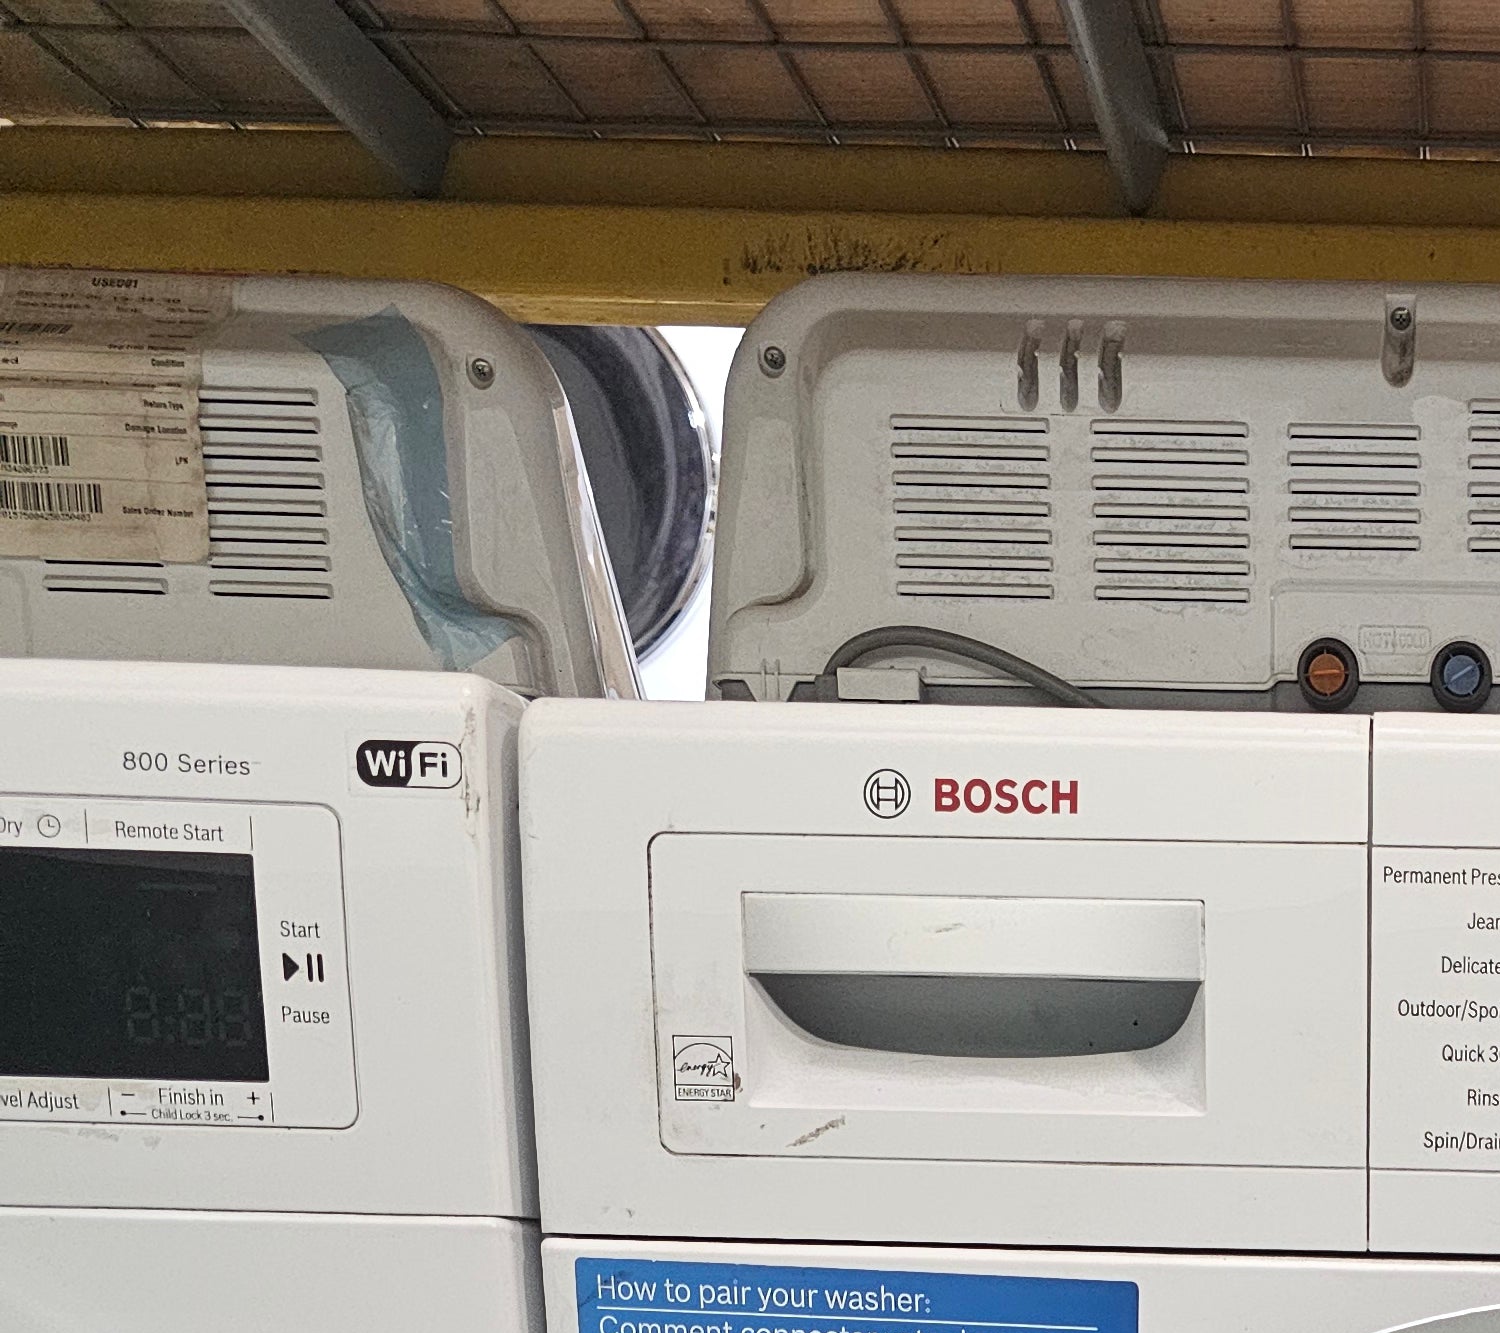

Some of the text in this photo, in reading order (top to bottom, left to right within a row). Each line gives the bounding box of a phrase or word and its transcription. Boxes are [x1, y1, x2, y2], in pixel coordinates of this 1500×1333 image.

[122, 752, 251, 776] 800 Series
[934, 778, 1079, 814] BOSCH
[115, 821, 224, 842] Remote Start
[1383, 866, 1467, 885] Permanent
[280, 920, 320, 939] Start
[281, 1006, 330, 1025] Pause
[1442, 1044, 1485, 1063] Quick
[28, 1091, 79, 1112] Adjust
[158, 1088, 224, 1105] Finish in
[678, 1088, 731, 1098] ENERGY STAR
[152, 1110, 177, 1120] Child
[179, 1110, 201, 1120] Lock
[204, 1111, 211, 1120] 3
[597, 1274, 931, 1313] How to pair your washer:
